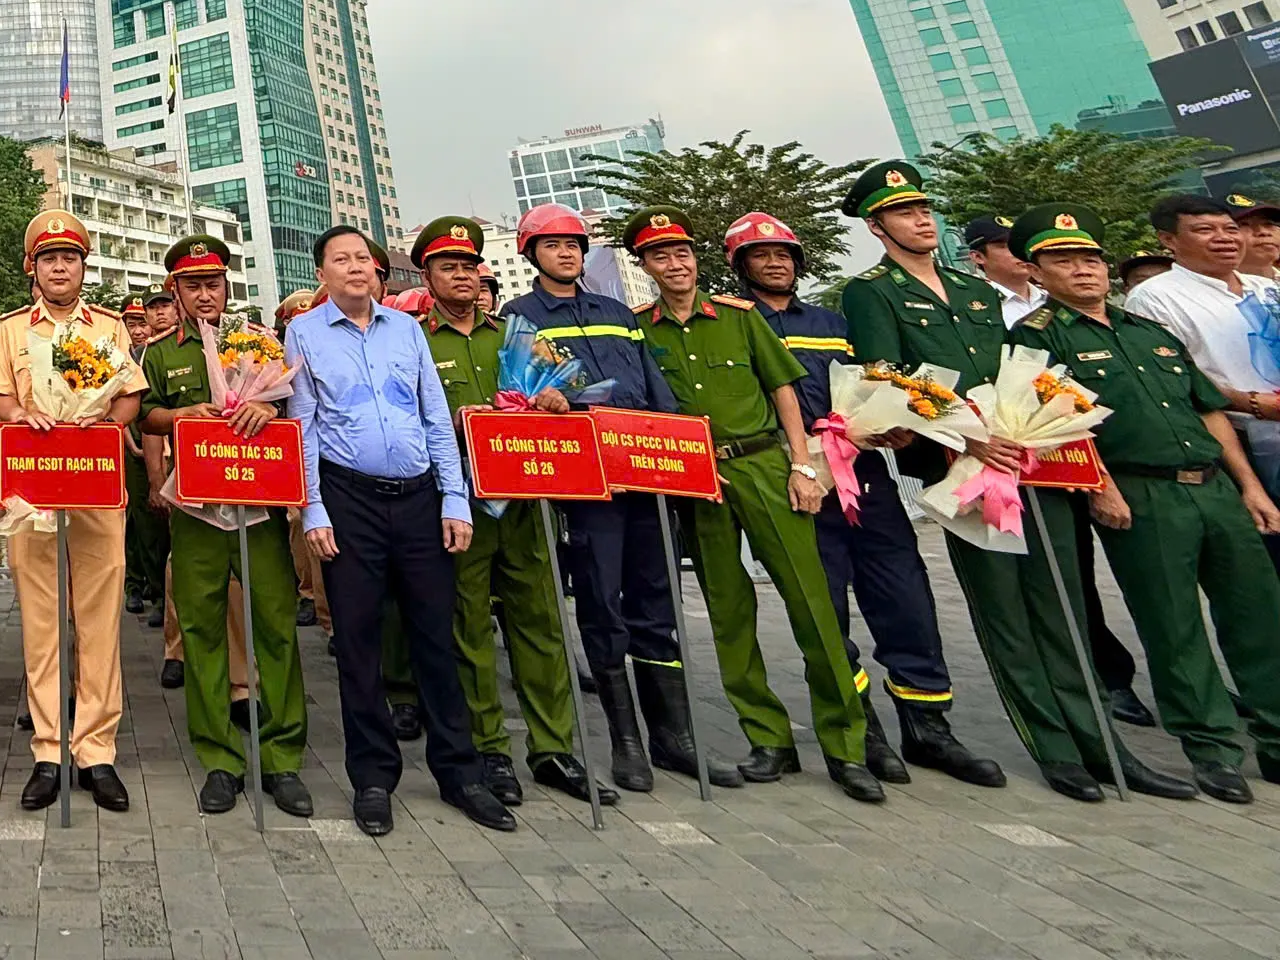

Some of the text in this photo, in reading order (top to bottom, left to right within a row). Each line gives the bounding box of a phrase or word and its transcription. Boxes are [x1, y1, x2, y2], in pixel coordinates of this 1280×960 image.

[1176, 88, 1252, 116] Panasonic
[564, 124, 602, 137] SUNWAH
[303, 164, 317, 178] SCB
[210, 442, 238, 458] CÔNG
[240, 443, 261, 459] TÁC
[263, 447, 283, 460] 363
[505, 436, 536, 453] CÔNG
[536, 437, 558, 453] TÁC
[560, 440, 580, 454] 363
[601, 430, 706, 454] ĐỘI CS PCCC VÀ CNCH
[6, 457, 116, 474] TRẠM CSĐT RẠCH TRA
[629, 453, 685, 473] TRÊN SÔNG
[1065, 447, 1089, 466] HỘI
[224, 462, 255, 481] SỐ 25
[523, 457, 554, 475] SỐ 26
